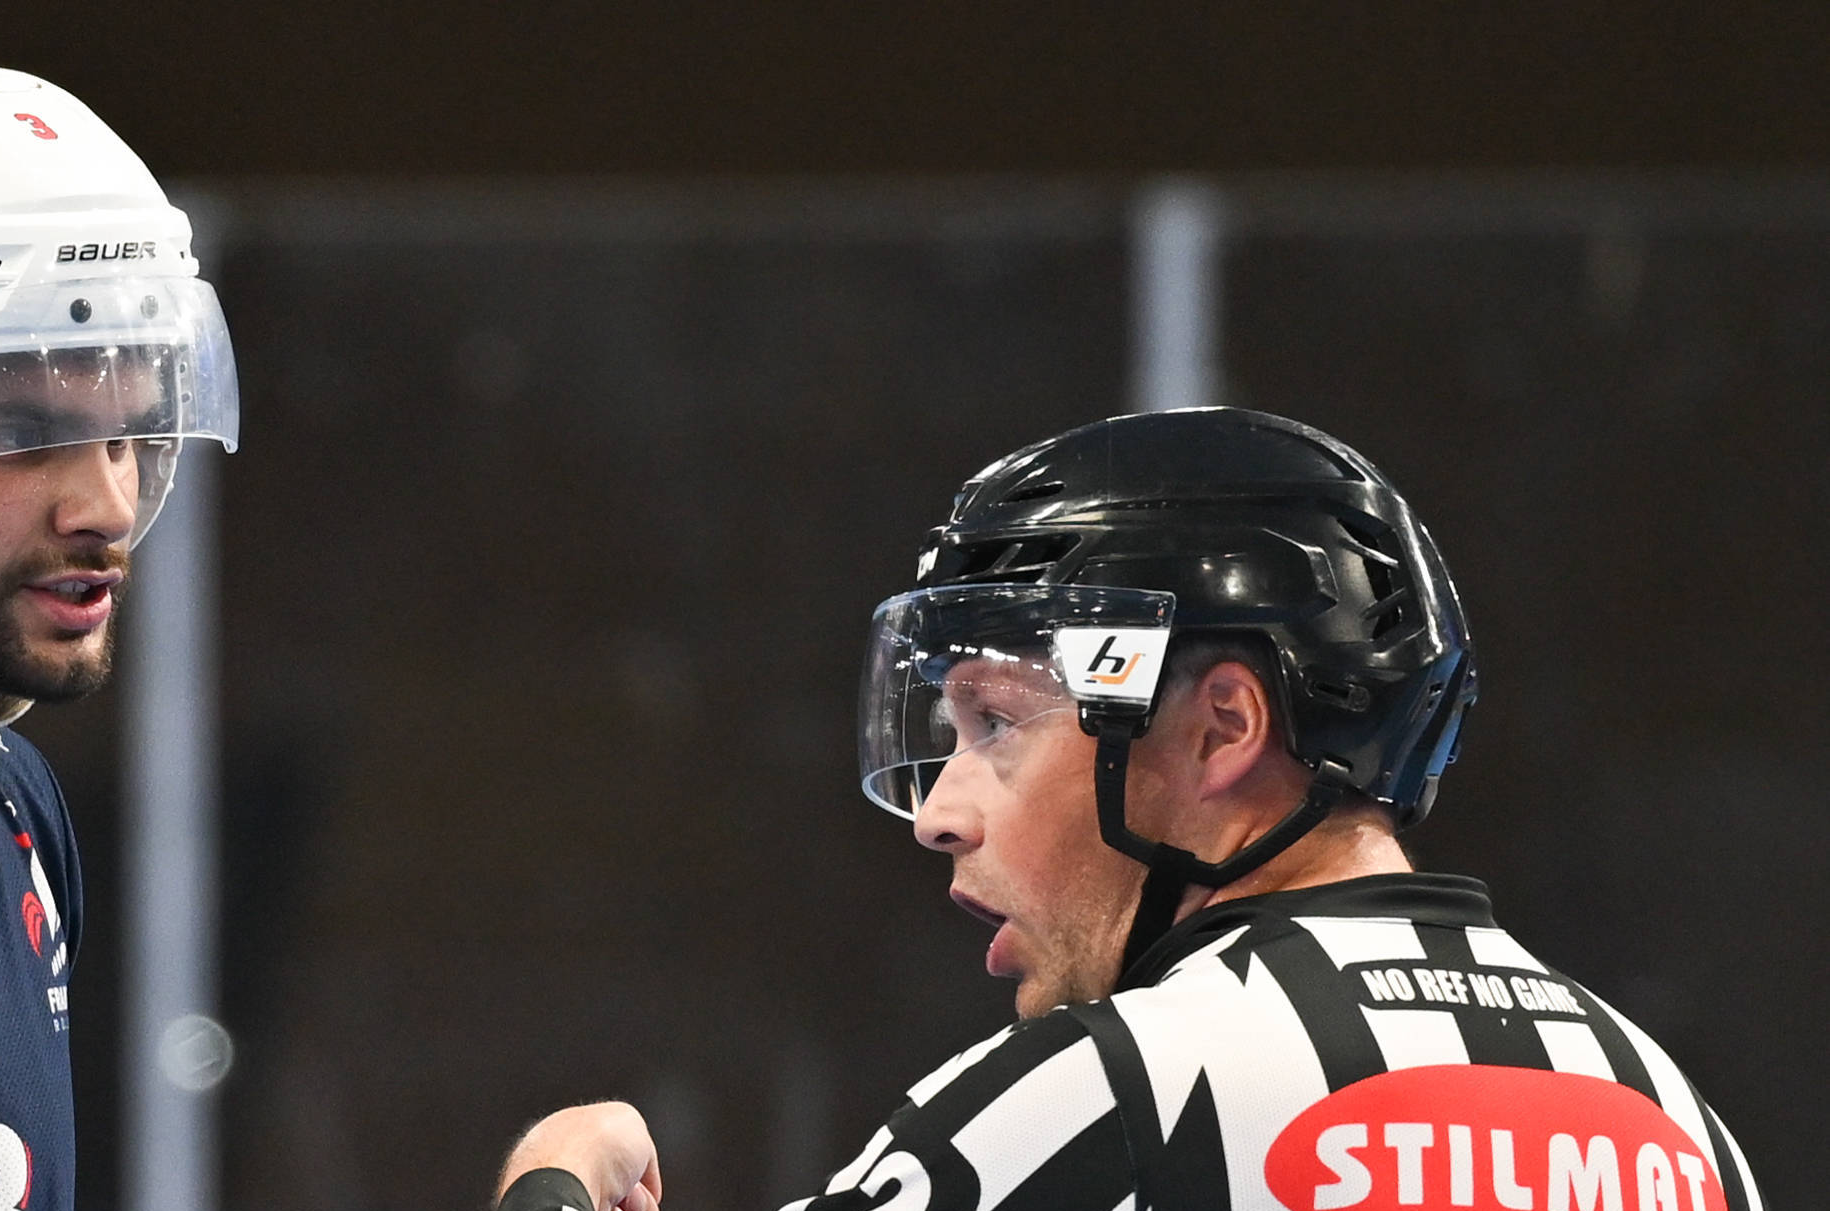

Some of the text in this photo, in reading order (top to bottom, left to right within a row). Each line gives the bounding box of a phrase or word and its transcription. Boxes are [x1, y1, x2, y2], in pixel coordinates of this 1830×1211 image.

[13, 112, 58, 140] 3
[1360, 968, 1416, 1001] NO
[1412, 968, 1470, 1005] REF
[1467, 973, 1514, 1010] NO
